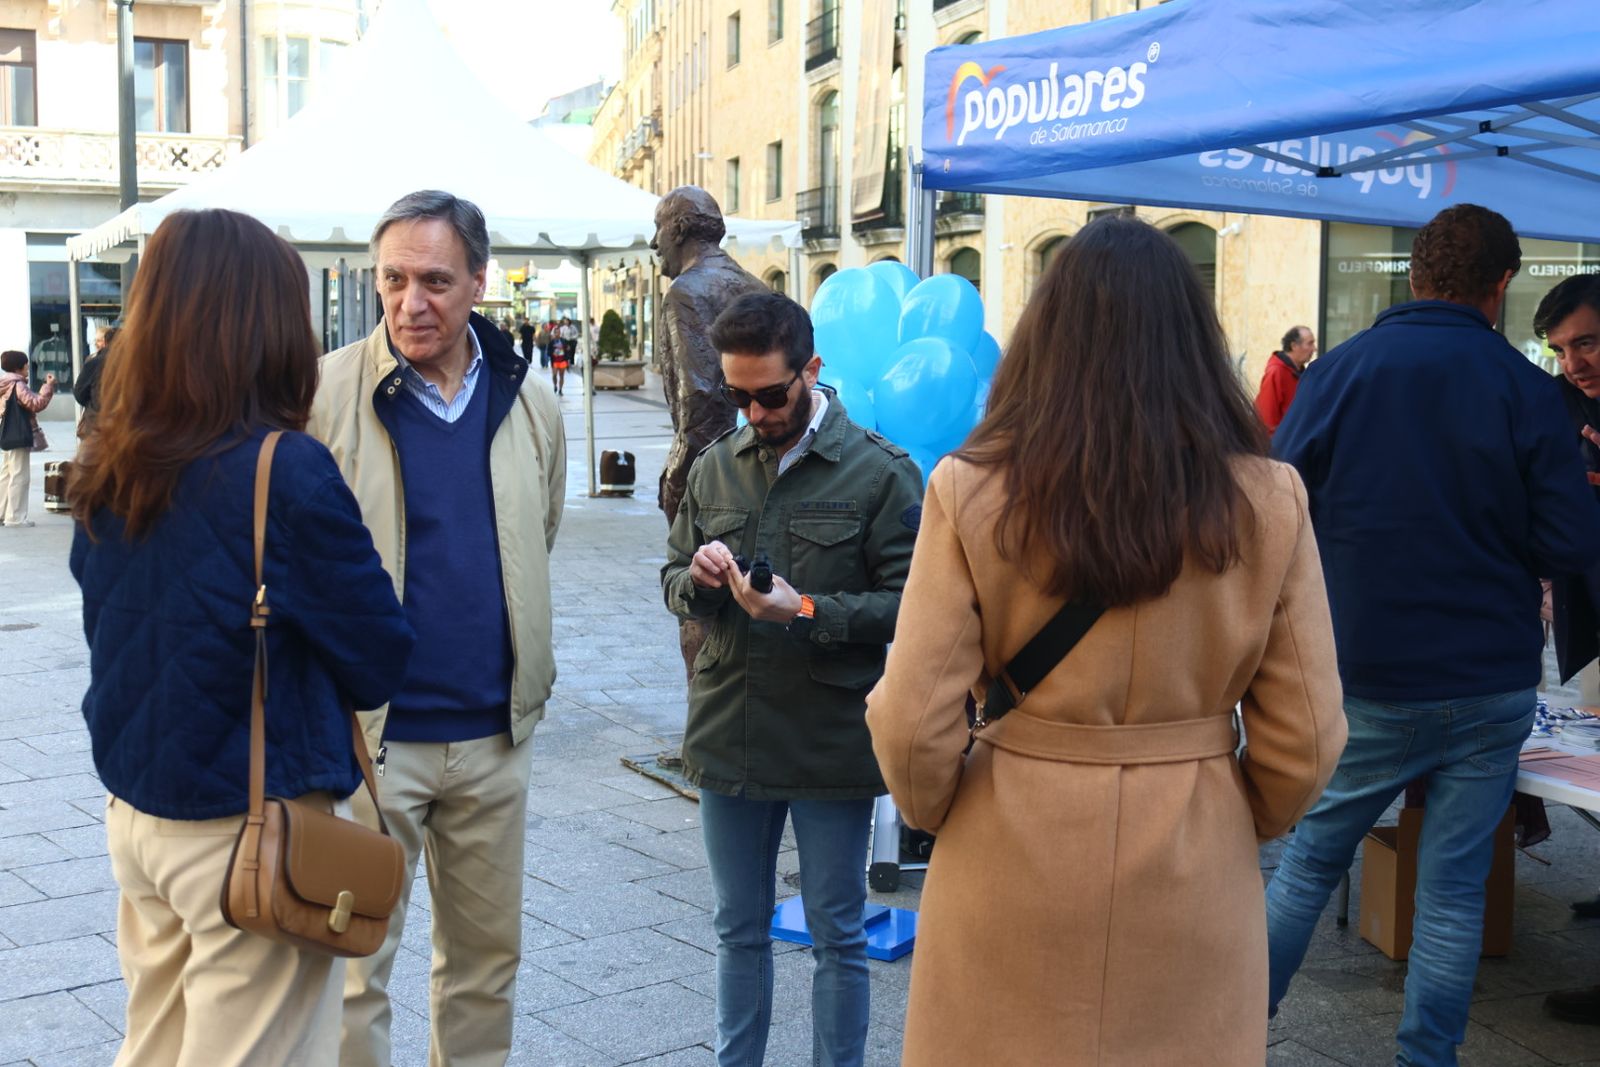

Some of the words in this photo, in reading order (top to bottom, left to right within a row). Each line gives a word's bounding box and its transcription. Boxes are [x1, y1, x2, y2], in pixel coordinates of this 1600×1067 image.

[957, 62, 1147, 146] populares
[1030, 123, 1046, 146] de
[1049, 116, 1128, 143] Salamanca
